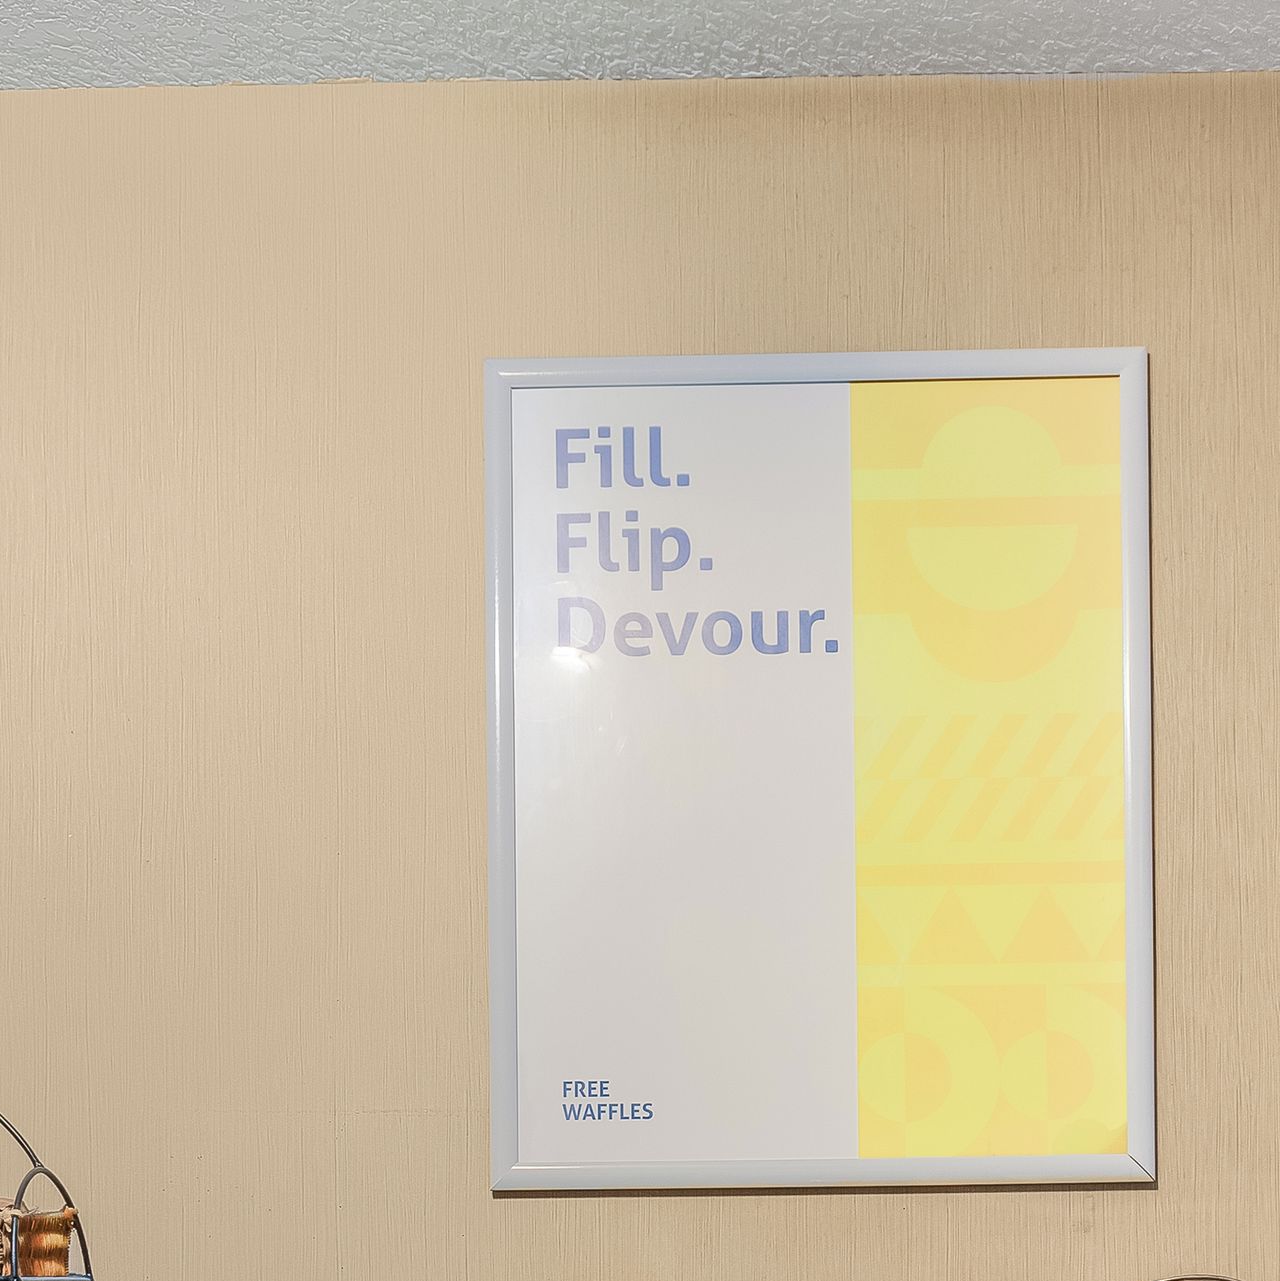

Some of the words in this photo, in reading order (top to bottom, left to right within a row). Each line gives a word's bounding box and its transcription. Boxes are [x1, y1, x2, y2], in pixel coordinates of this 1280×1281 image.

[555, 426, 690, 489] Fill.
[556, 510, 713, 591] Flip.
[557, 596, 838, 657] Devour.
[562, 1080, 610, 1098] FREE
[562, 1103, 654, 1121] WAFFLES
